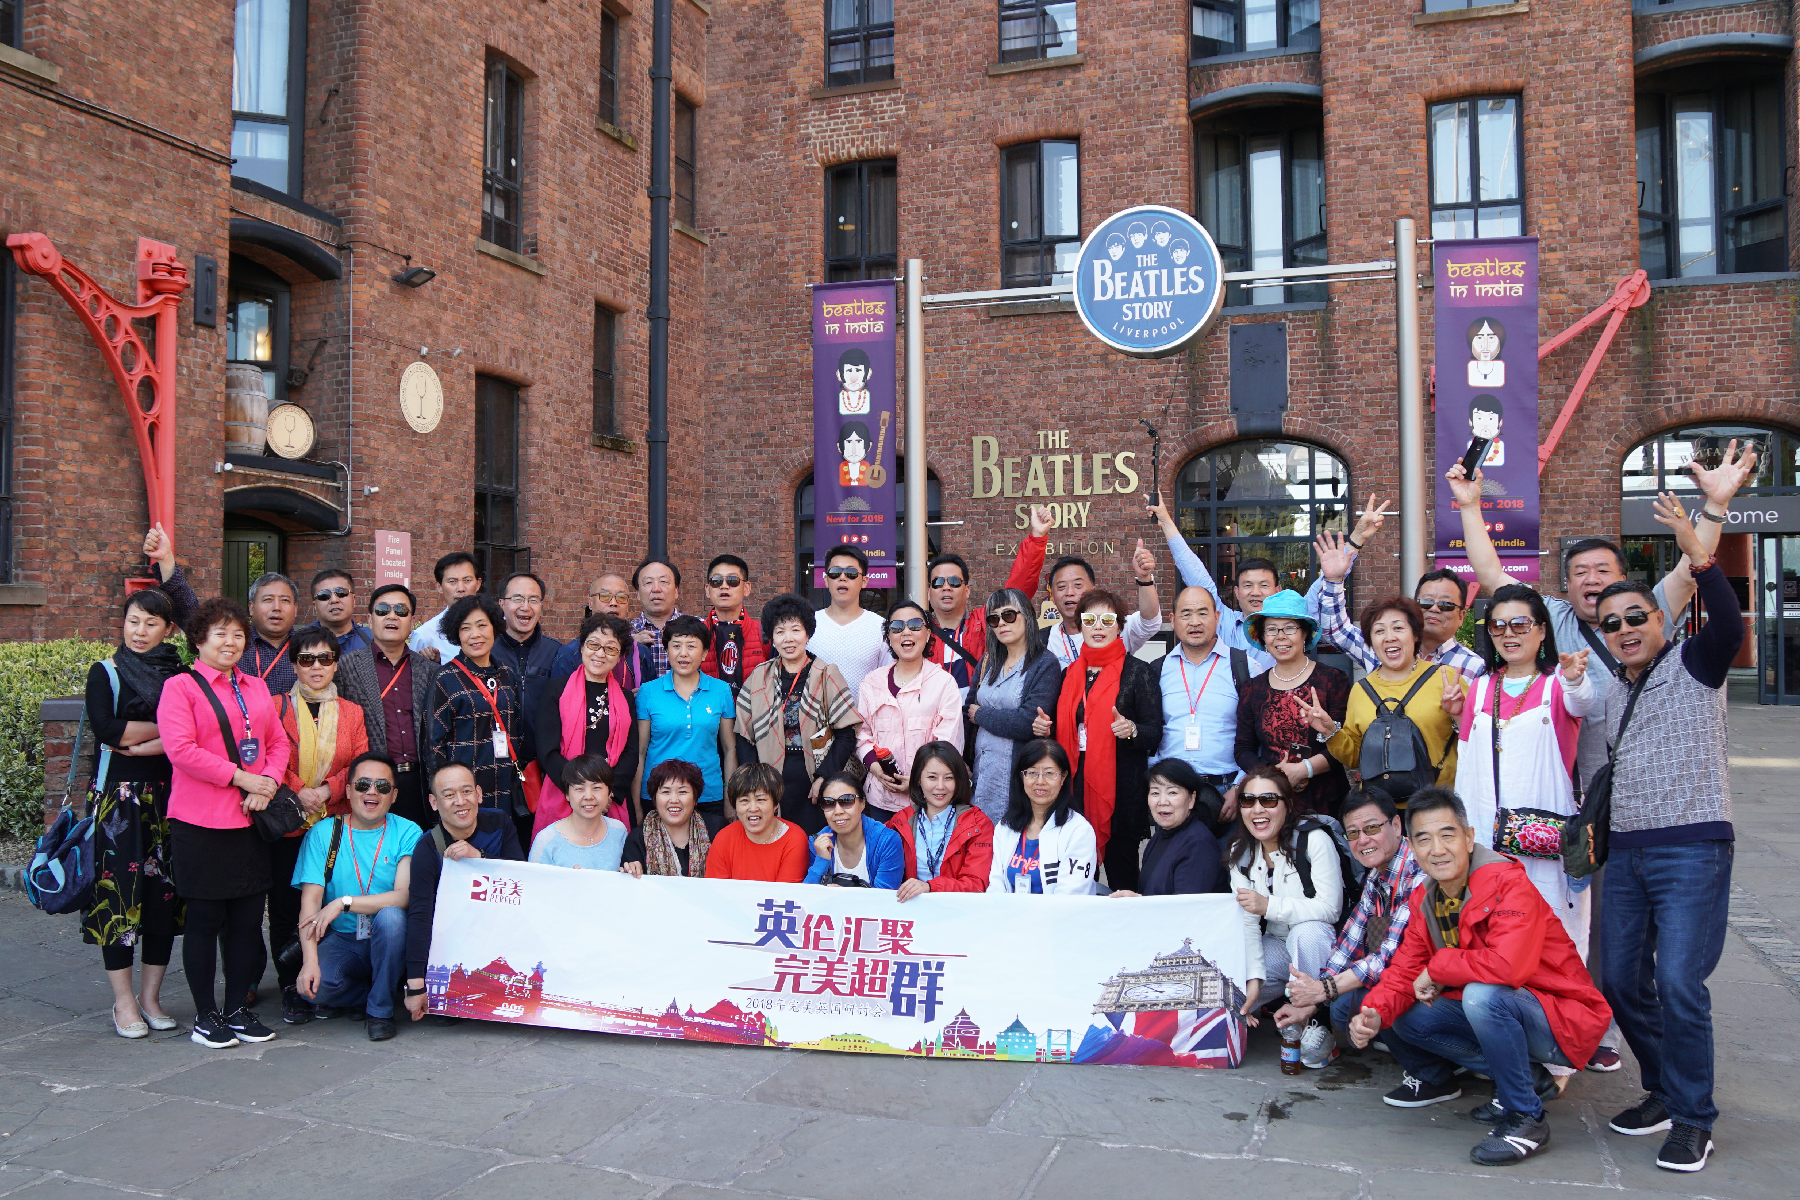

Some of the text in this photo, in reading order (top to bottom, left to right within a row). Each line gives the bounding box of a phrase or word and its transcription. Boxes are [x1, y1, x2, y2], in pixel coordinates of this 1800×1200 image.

[1136, 253, 1158, 267] THE
[1446, 257, 1526, 278] beatles
[1092, 259, 1205, 301] BEATLES
[1449, 280, 1524, 298] in india
[822, 299, 886, 318] beatles
[1122, 300, 1173, 321] STORY
[825, 318, 885, 335] in india
[1112, 317, 1185, 338] LIVERPOOL
[1037, 429, 1070, 449] THE
[971, 435, 1139, 499] BEATLES
[1496, 500, 1524, 509] 2018
[826, 515, 846, 523] New
[862, 514, 884, 523] 2018
[388, 535, 400, 543] Fire
[385, 547, 402, 555] Panel
[995, 541, 1115, 556] EXBITION
[381, 558, 406, 567] Located
[384, 570, 403, 578] inside
[328, 850, 336, 868] Nikon
[492, 877, 524, 897] 完美
[489, 893, 521, 905] PERFECT
[1492, 909, 1526, 918] PERFECT
[754, 898, 920, 957] 英伦汇聚
[771, 953, 946, 1024] 完美超群
